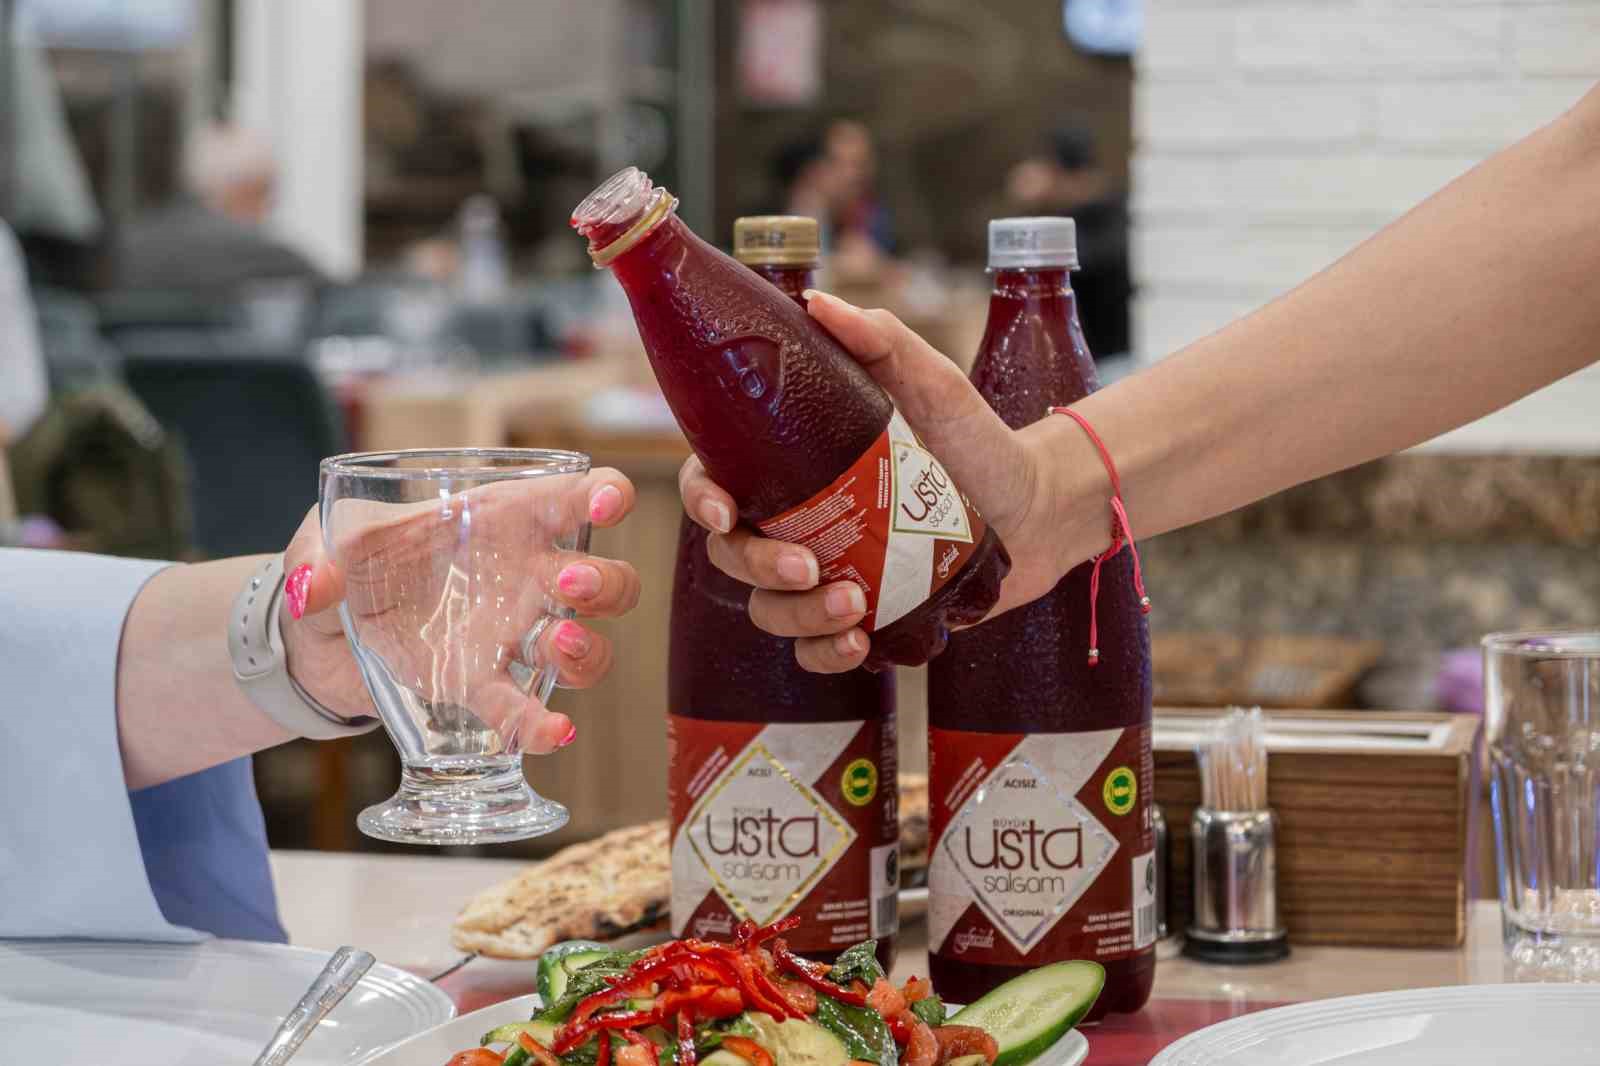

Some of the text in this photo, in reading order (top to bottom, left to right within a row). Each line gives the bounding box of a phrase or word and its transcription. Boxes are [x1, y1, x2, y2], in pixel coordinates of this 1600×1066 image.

[901, 460, 948, 522] usta
[706, 807, 820, 858] usta
[965, 819, 1083, 872] usta
